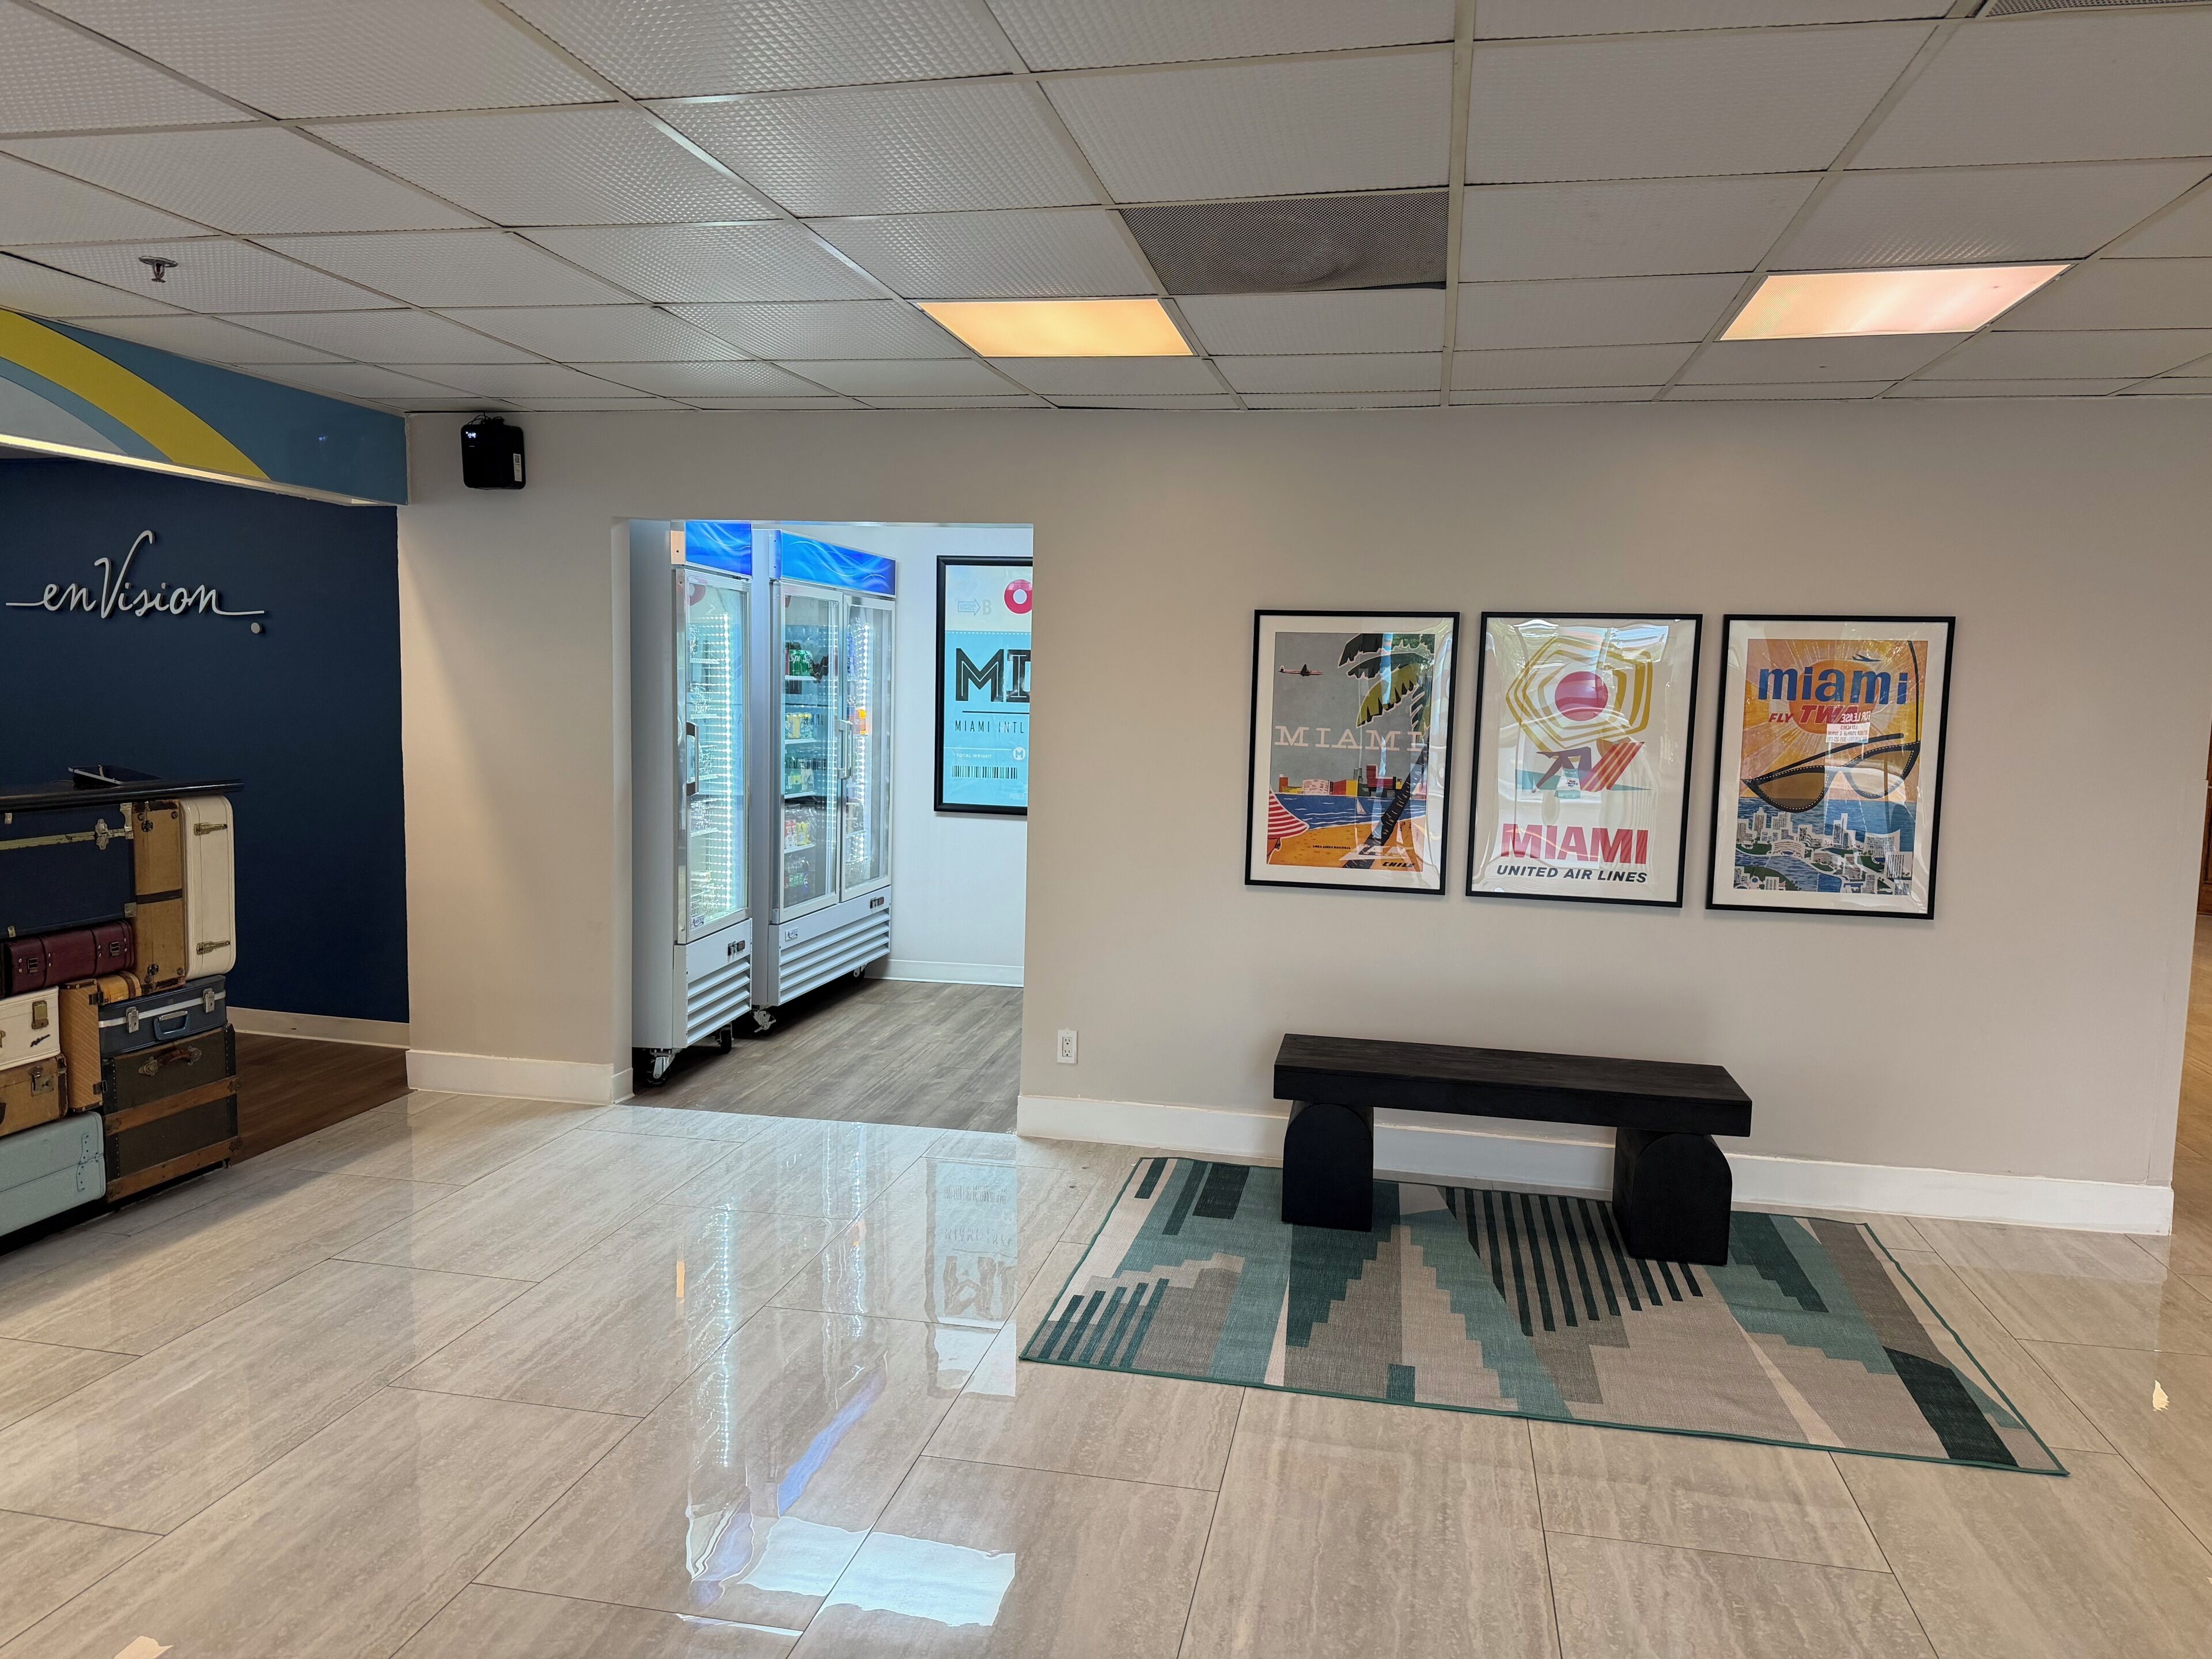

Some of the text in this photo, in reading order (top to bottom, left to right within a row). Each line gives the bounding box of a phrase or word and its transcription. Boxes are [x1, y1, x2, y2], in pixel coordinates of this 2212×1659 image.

[1758, 666, 1908, 705] miami
[955, 719, 1025, 734] MIAMI INTL
[1768, 704, 1860, 725] FLY TWA
[1274, 725, 1424, 752] MIAMI
[1501, 823, 1649, 865] MIAMI
[1496, 865, 1648, 883] UNITED AIR LINES
